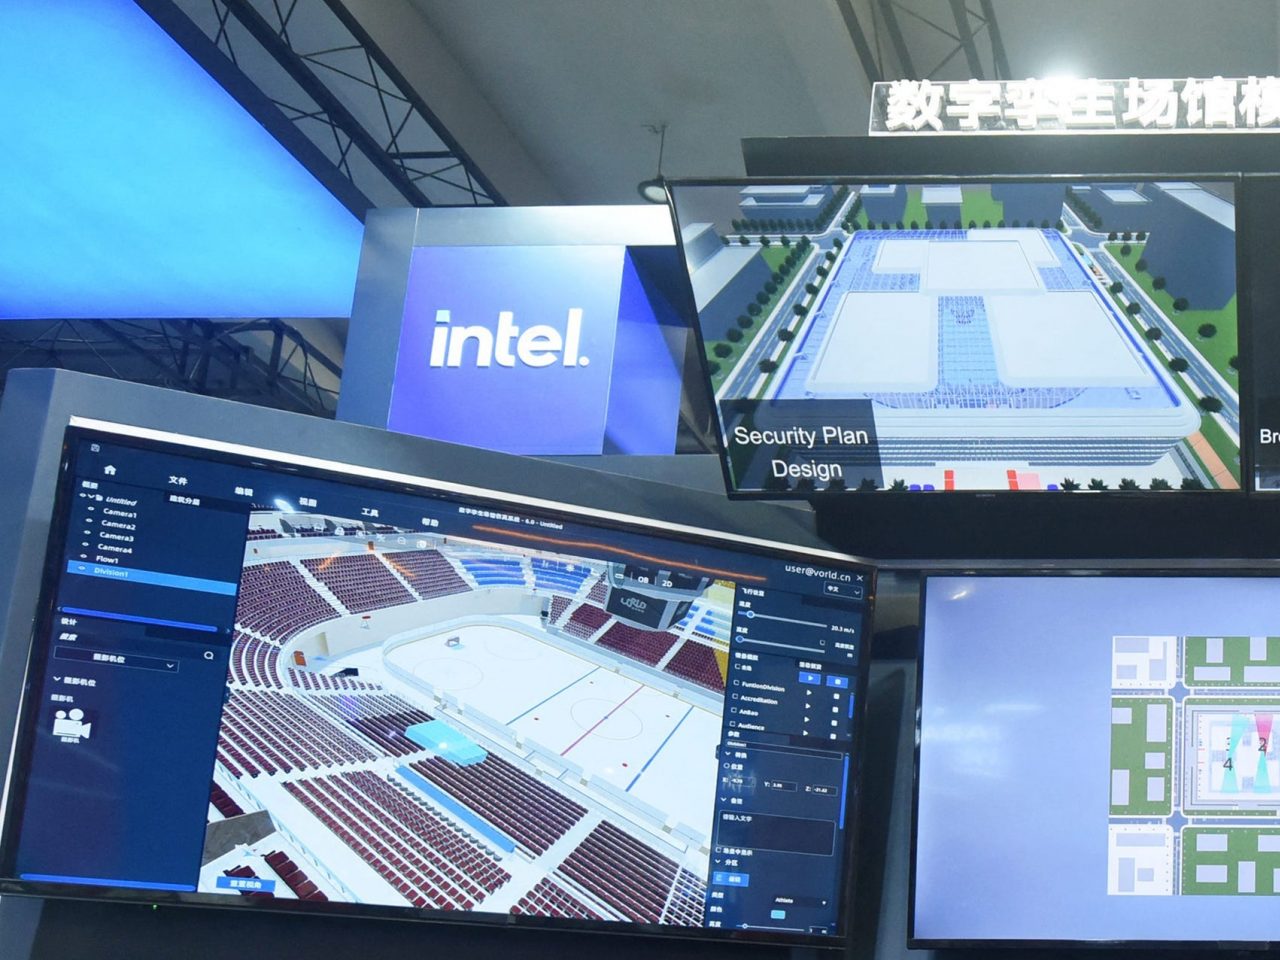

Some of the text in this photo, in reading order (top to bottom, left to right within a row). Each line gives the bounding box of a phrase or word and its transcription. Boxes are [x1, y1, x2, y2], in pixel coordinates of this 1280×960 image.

[734, 426, 869, 449] Security Plan
[771, 459, 842, 481] Design
[168, 475, 188, 486] 文件
[106, 496, 138, 506] Untitled
[103, 508, 138, 519] Camera1
[361, 507, 380, 518] 工具
[101, 519, 136, 531] Camera2
[99, 531, 134, 542] Camera3
[97, 543, 133, 554] Camera4
[96, 555, 119, 564] Flow1
[94, 567, 129, 577] Division1
[785, 563, 851, 582] user@vorld.cn
[740, 694, 778, 705] Accreditation
[737, 722, 765, 731] Audience
[1258, 737, 1267, 752] 2
[1223, 758, 1233, 771] 4
